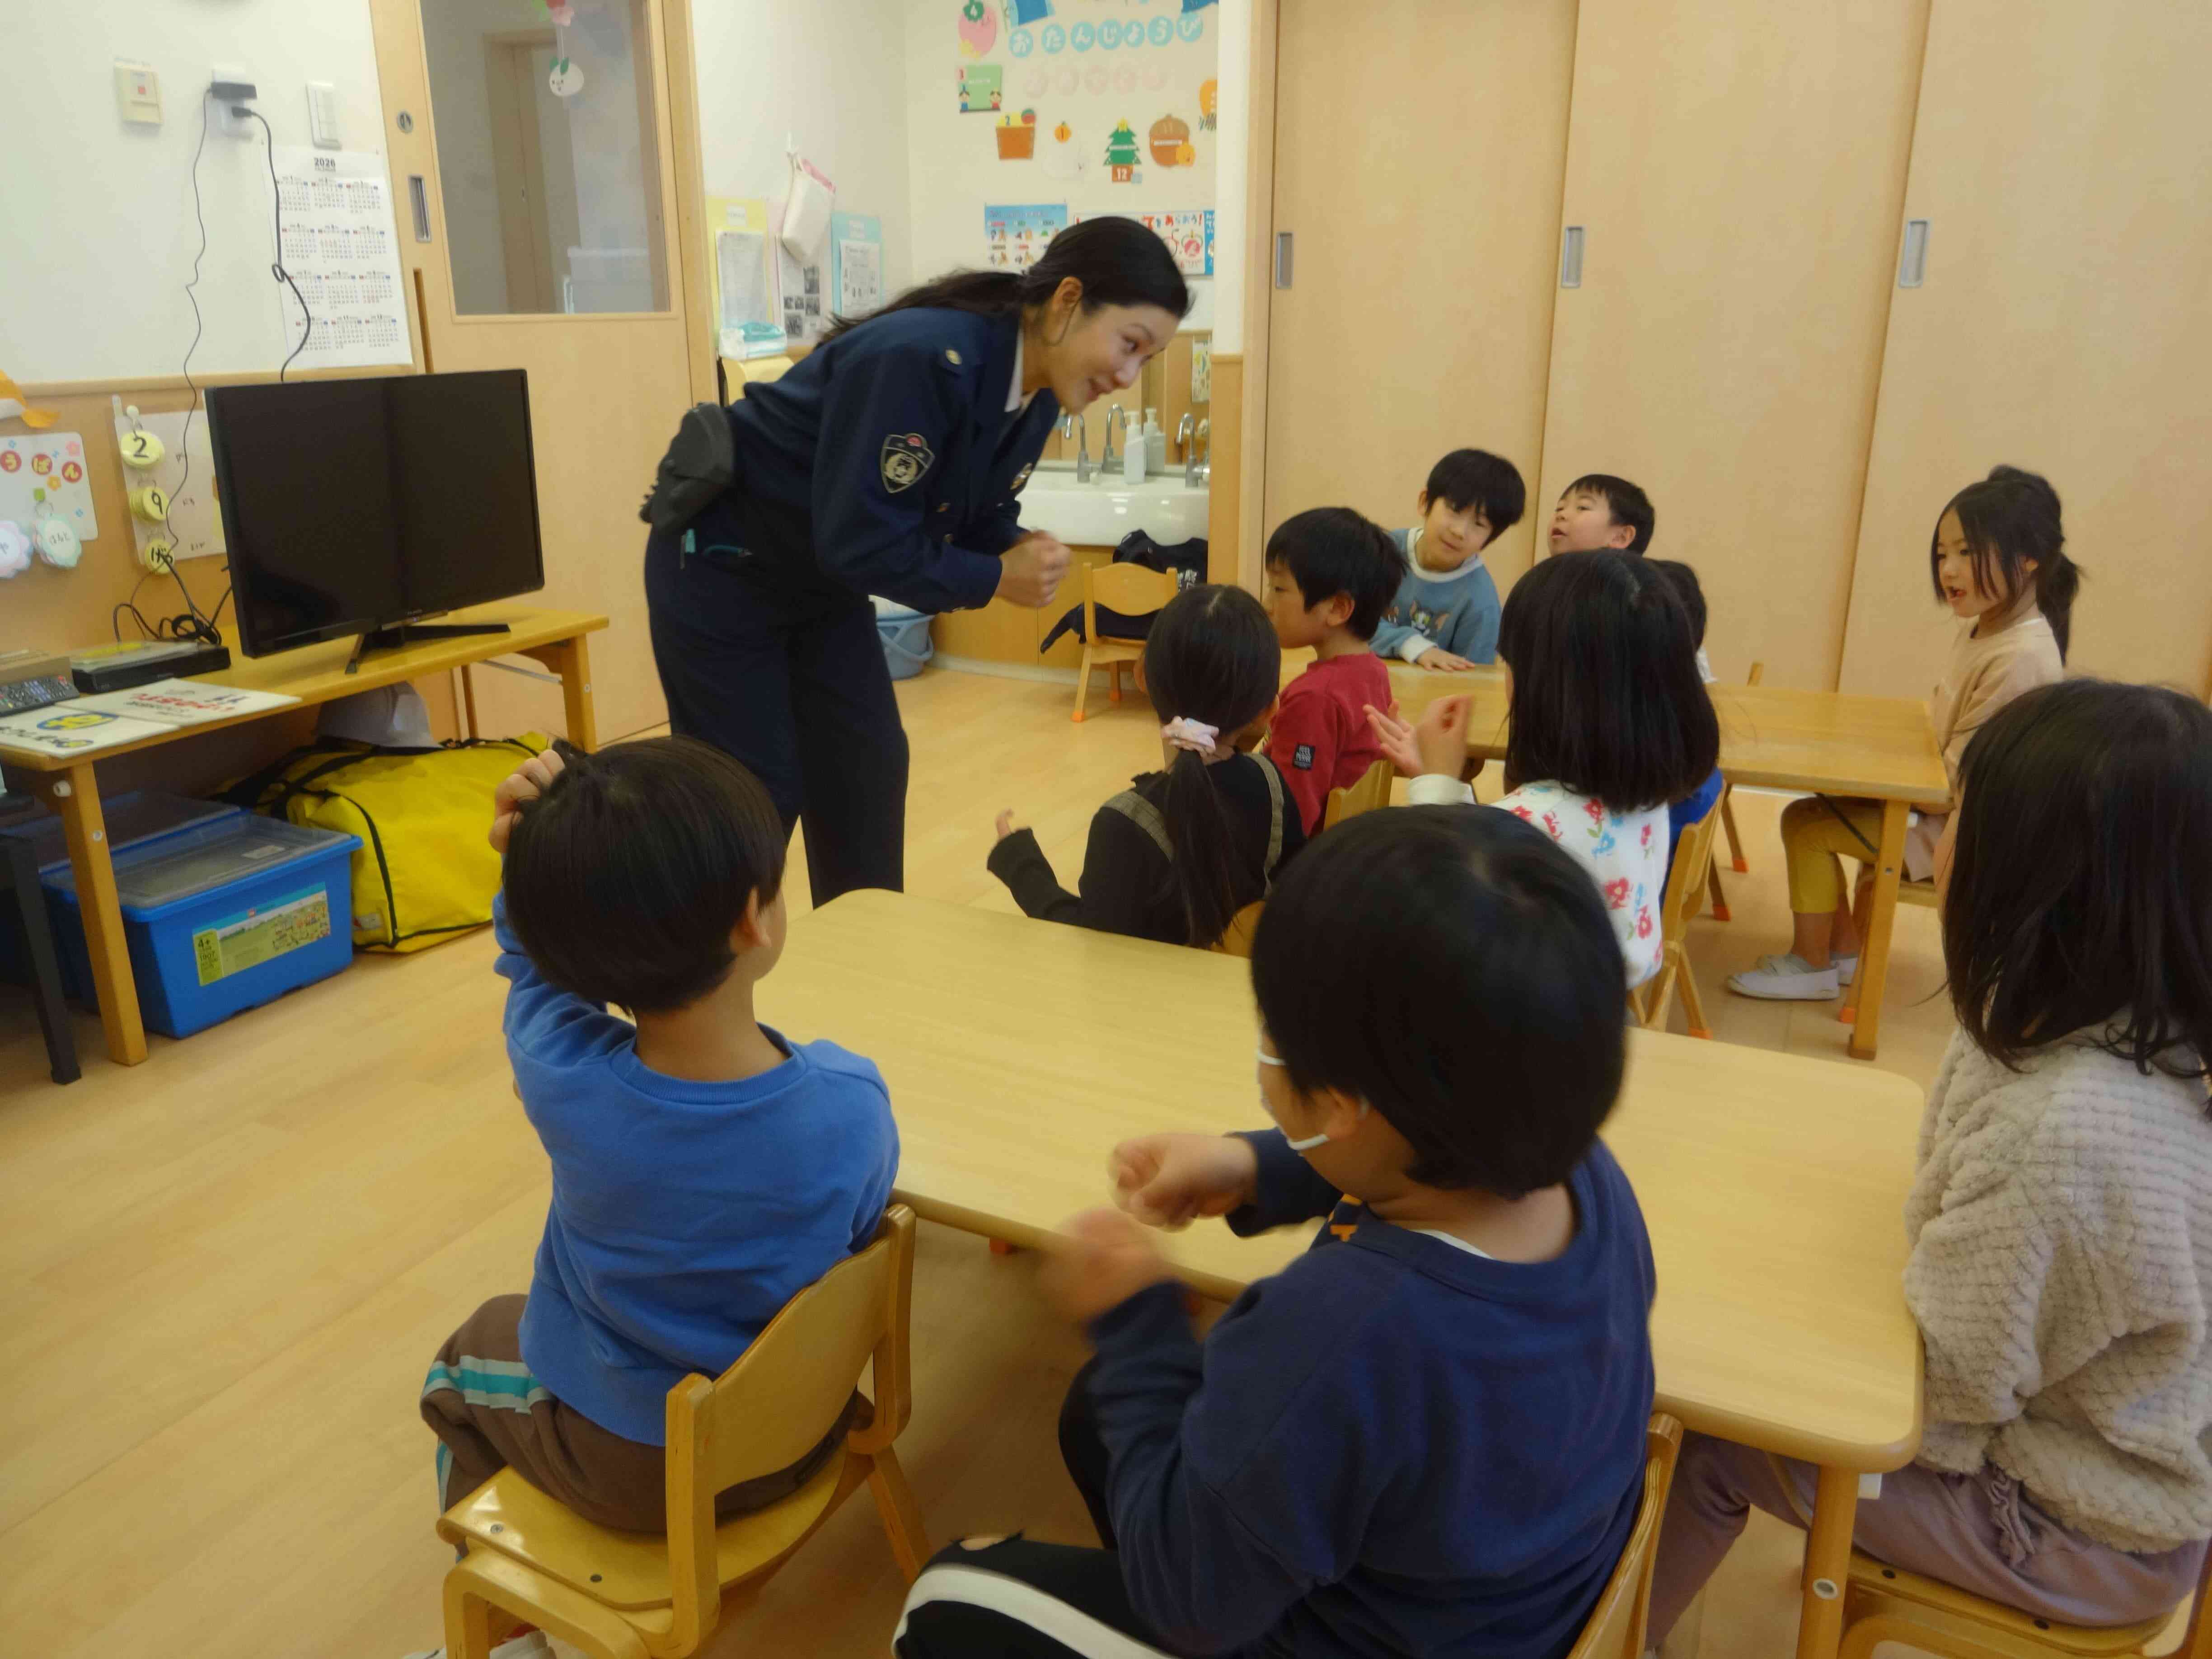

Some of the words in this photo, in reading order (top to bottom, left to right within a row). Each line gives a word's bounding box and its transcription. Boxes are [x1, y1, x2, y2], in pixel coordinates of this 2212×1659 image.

[970, 4, 978, 17] 4
[1012, 15, 1201, 53] おたんじょうび
[314, 157, 336, 167] 2026
[1116, 168, 1128, 180] 12
[134, 436, 149, 458] 2
[5, 453, 80, 480] うばん
[151, 490, 163, 515] 9
